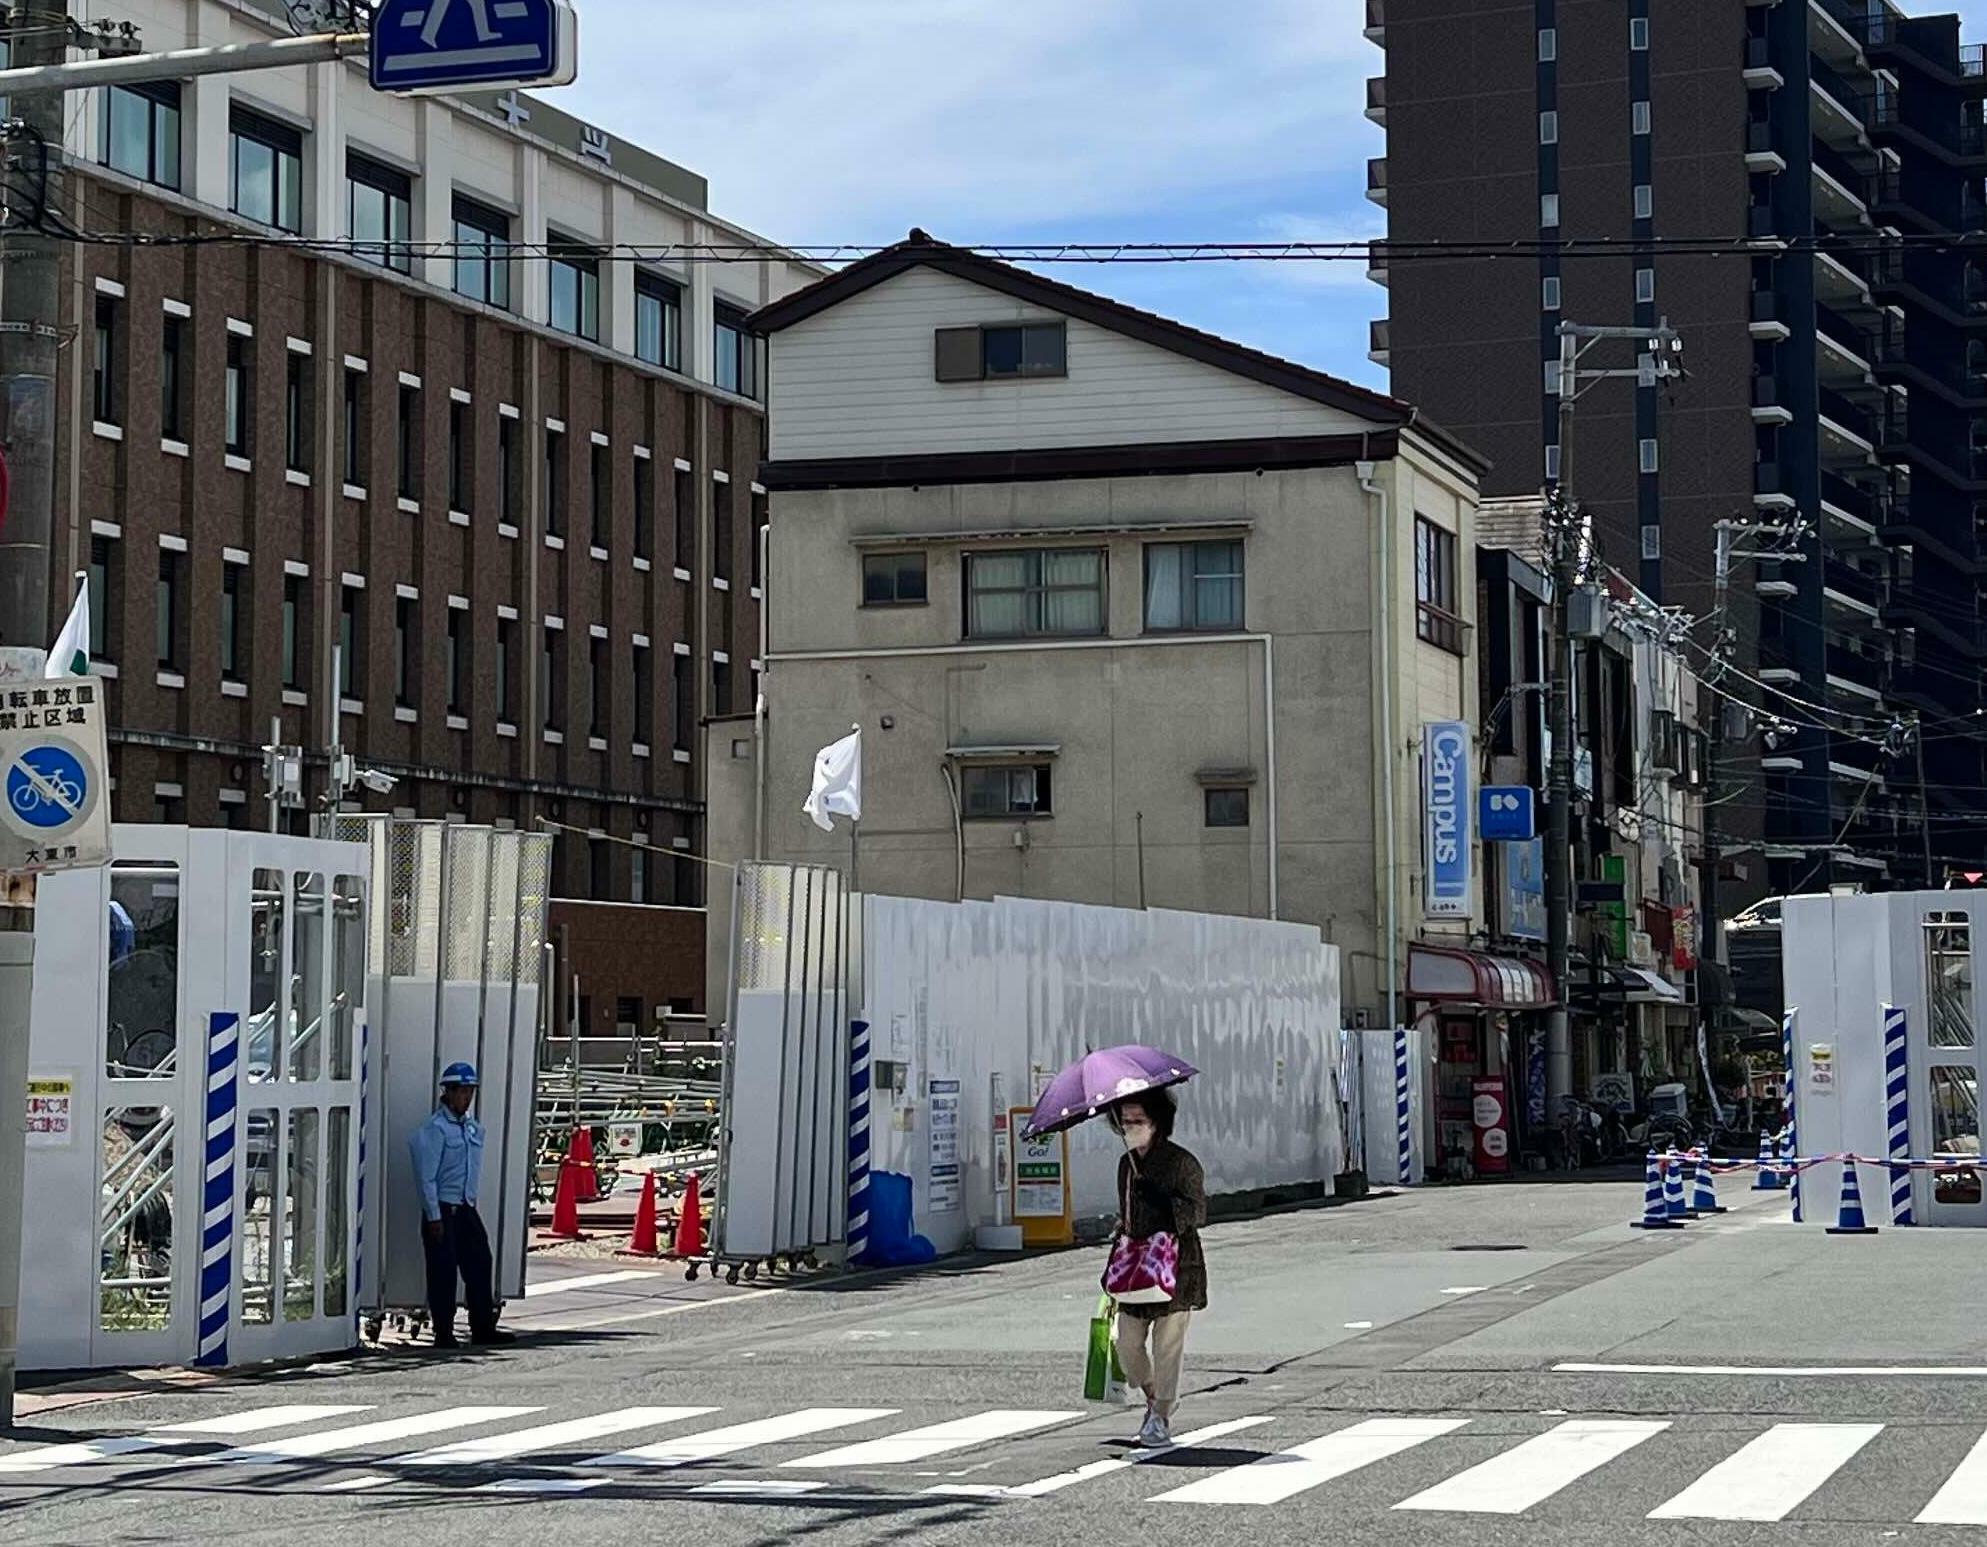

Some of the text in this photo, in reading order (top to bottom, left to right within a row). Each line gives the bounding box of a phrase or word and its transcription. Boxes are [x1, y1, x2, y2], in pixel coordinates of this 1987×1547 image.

[0, 685, 95, 711] 転車放置
[0, 706, 86, 730] 禁止区域
[1428, 730, 1464, 865] Campus
[25, 845, 78, 863] 大東市
[1028, 1146, 1049, 1158] Go!
